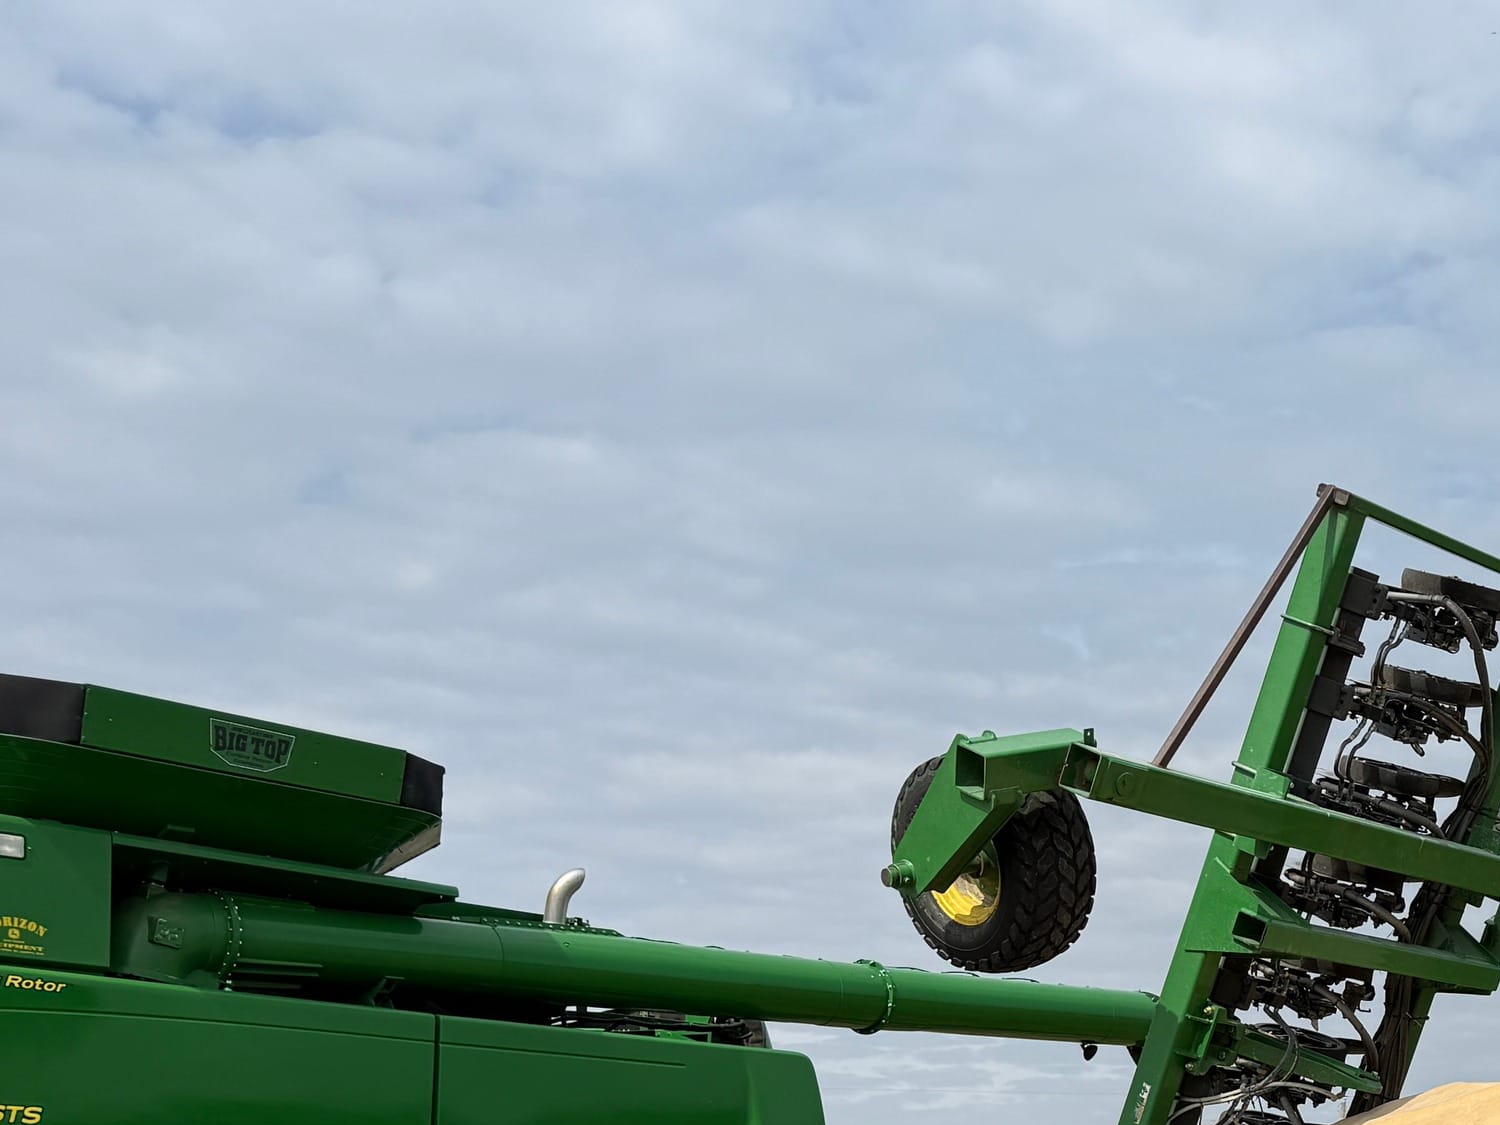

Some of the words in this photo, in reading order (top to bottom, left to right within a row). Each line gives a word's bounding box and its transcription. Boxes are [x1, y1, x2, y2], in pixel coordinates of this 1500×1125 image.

[214, 725, 248, 752] BIG
[251, 736, 292, 764] TOP
[0, 916, 48, 937] RIZON
[5, 975, 67, 993] Rotor
